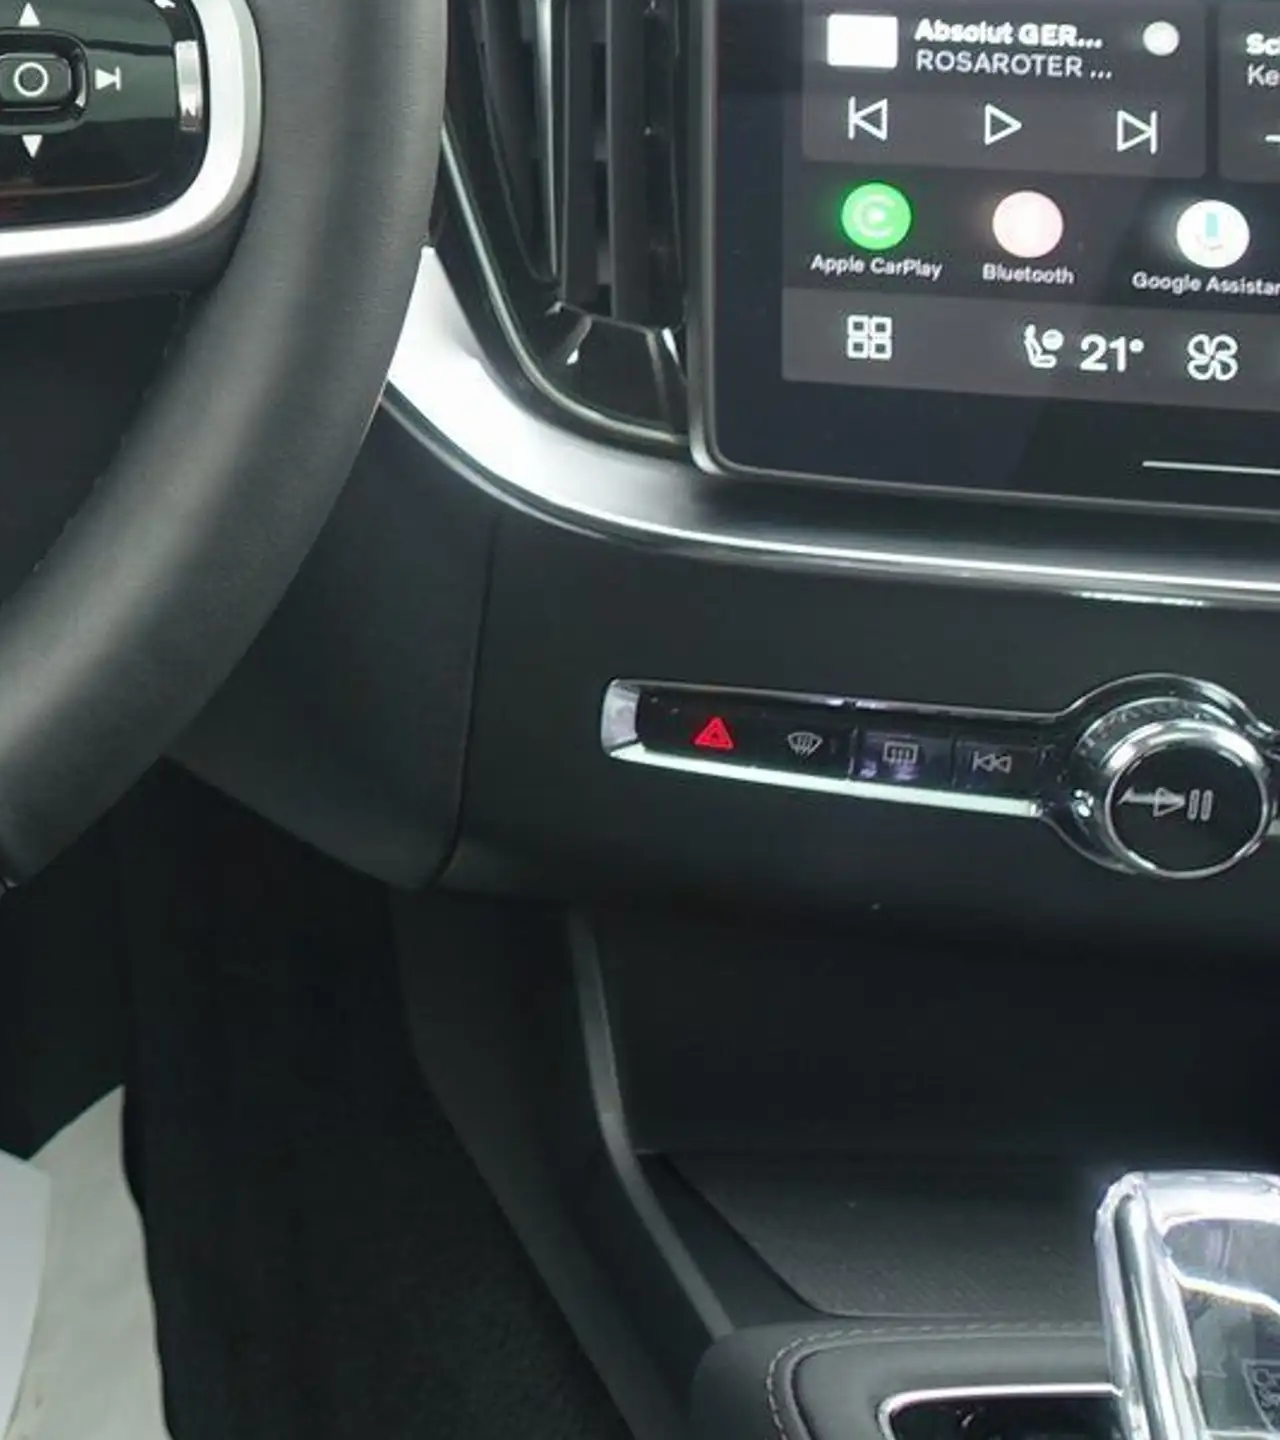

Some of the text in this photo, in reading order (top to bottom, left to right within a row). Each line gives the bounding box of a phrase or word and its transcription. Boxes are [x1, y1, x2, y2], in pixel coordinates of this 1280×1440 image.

[914, 17, 1014, 45] Absolut
[915, 48, 1083, 78] ROSAROTER
[810, 254, 943, 282] Apple CarPlay
[982, 262, 1075, 285] Bluetooth
[1131, 270, 1202, 295] Google
